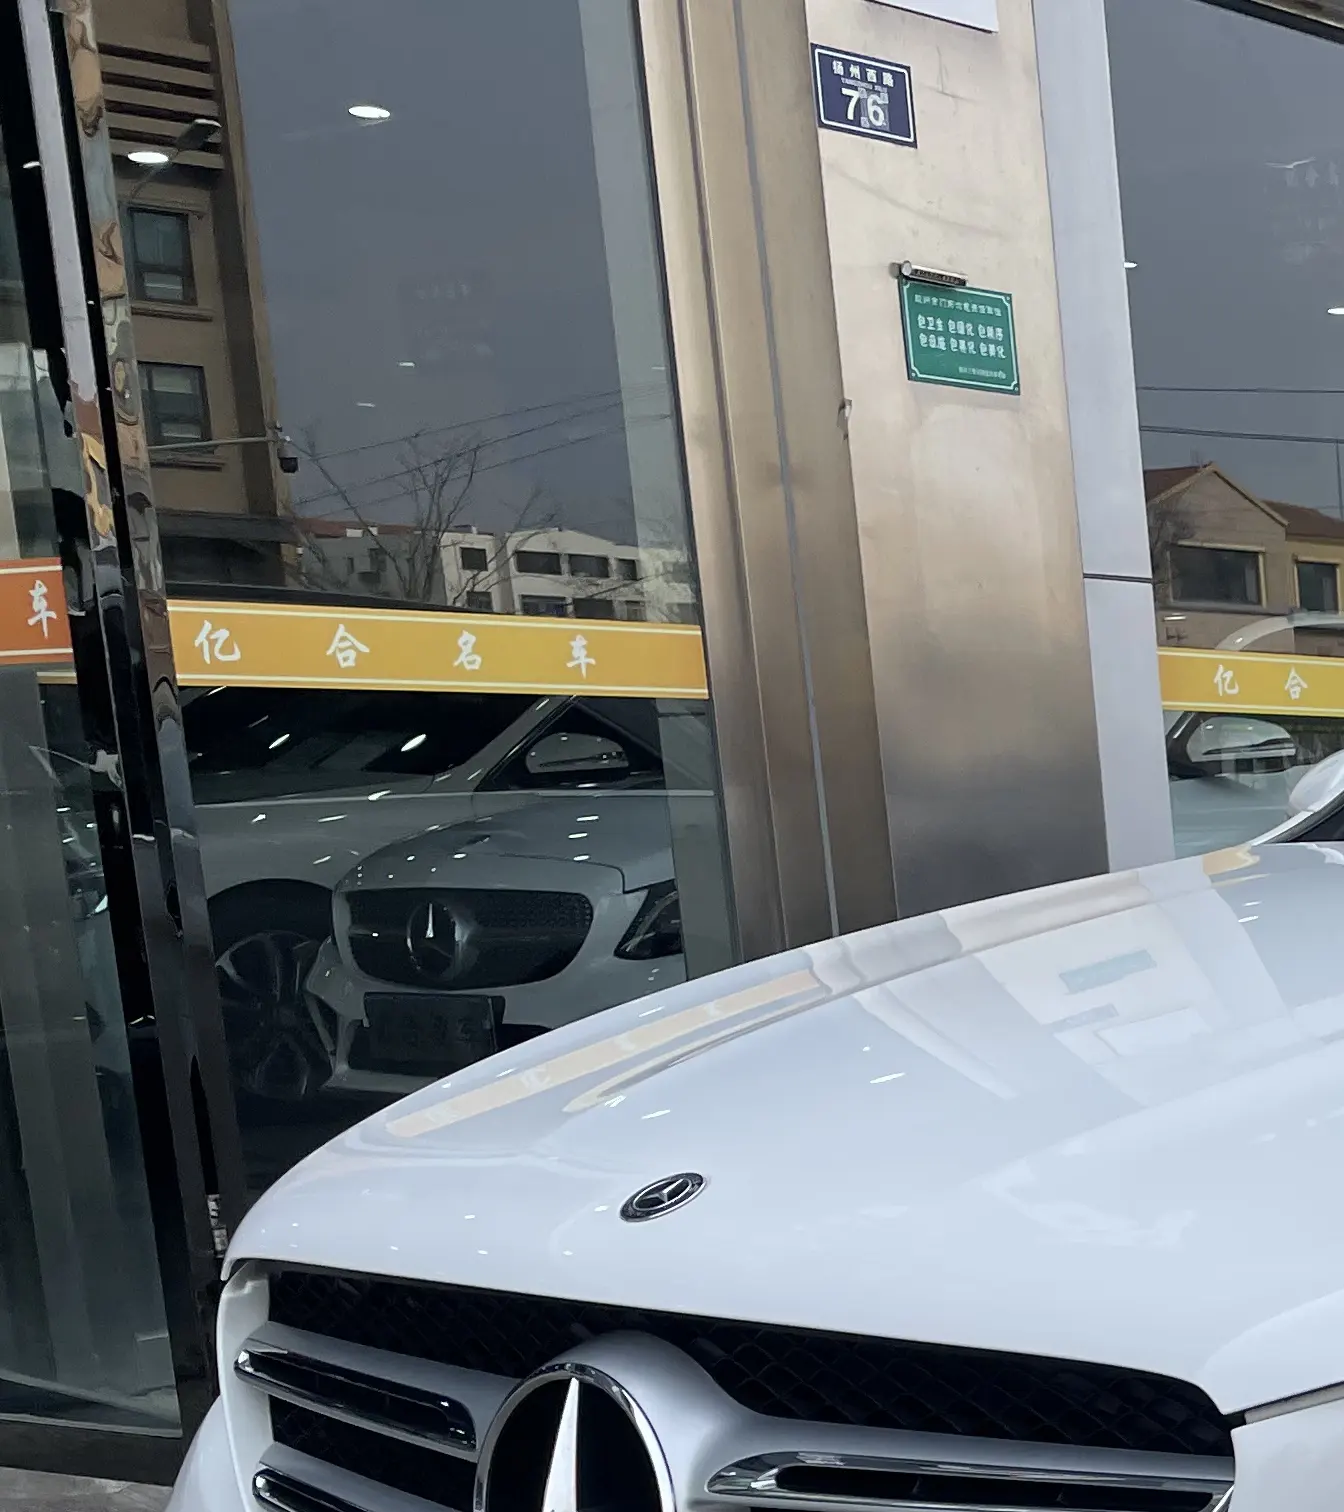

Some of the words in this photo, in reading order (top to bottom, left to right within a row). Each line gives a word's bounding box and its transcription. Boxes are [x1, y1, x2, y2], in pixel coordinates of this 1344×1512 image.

[841, 87, 885, 127] 76
[194, 620, 596, 677] 亿合名车
